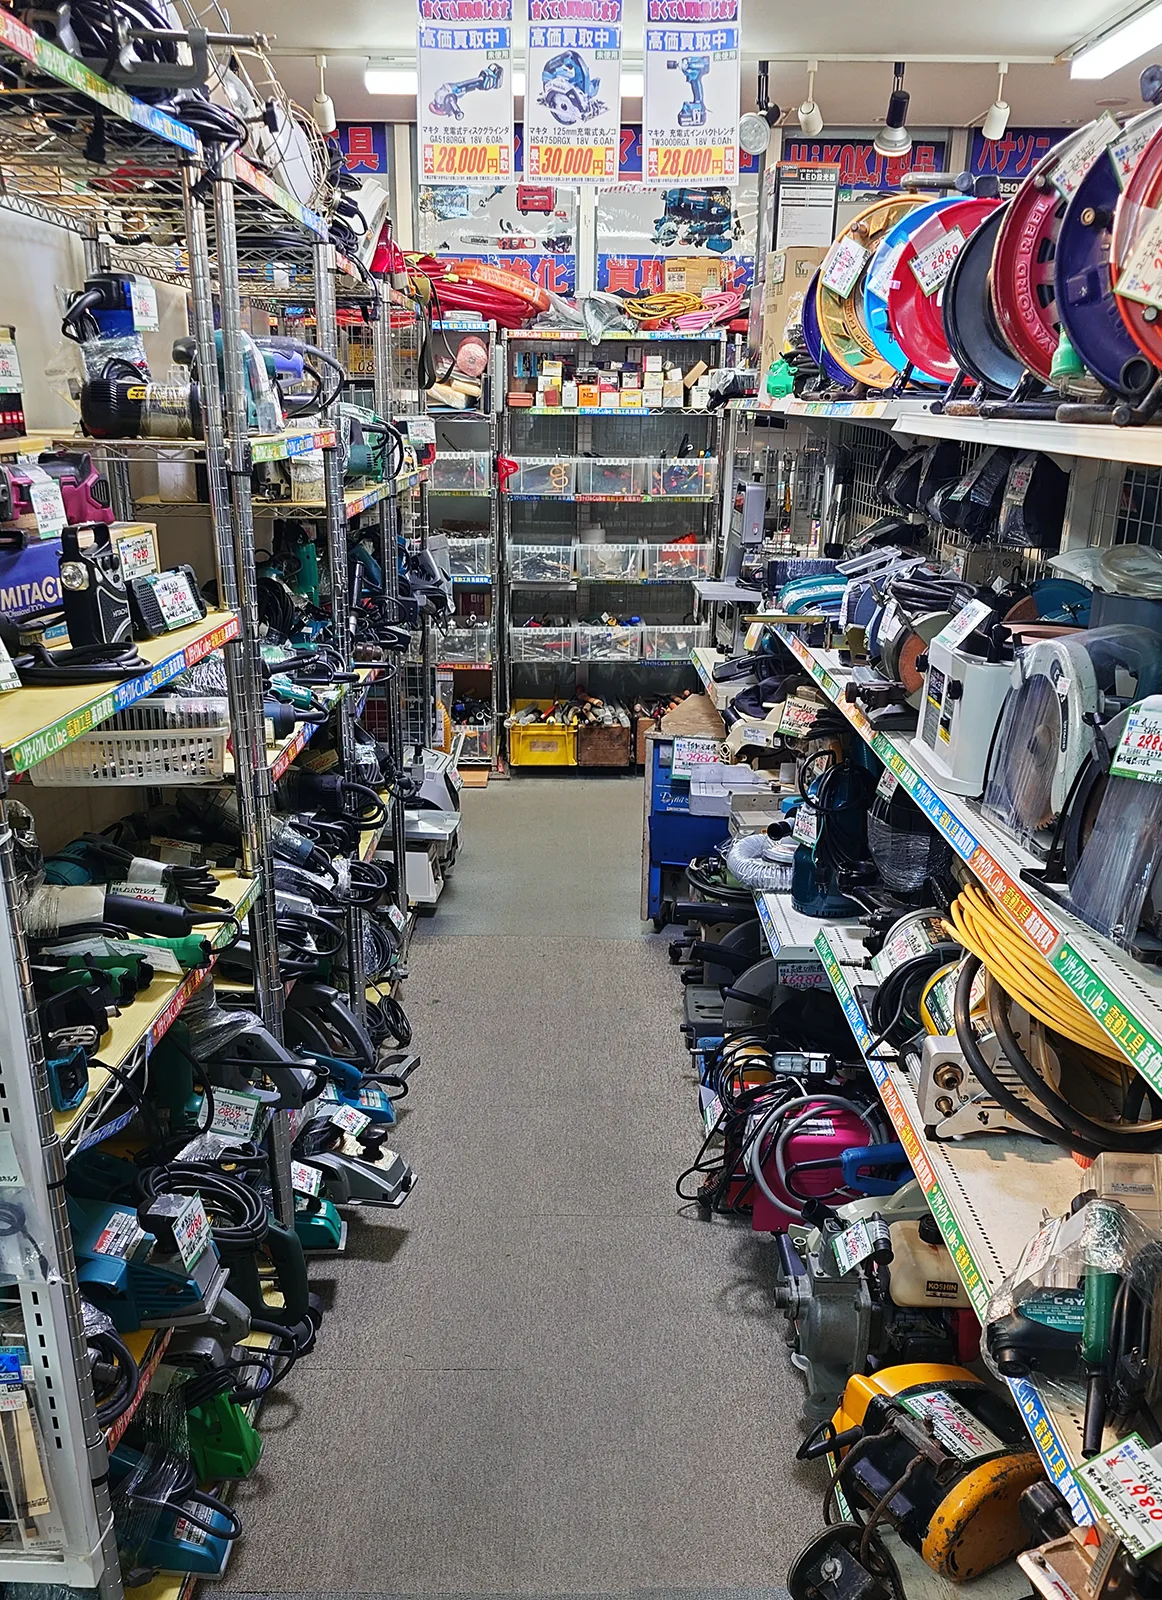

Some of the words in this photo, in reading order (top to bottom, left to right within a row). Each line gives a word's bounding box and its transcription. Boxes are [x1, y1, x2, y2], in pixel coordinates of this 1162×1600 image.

[422, 126, 440, 134] マキタ
[529, 127, 548, 135] マキタ
[648, 129, 665, 137] マキタ
[471, 136, 483, 144] 18V
[486, 136, 504, 144] 6.0Ah
[576, 137, 589, 145] 18V
[593, 137, 615, 145] 6.0Ah
[695, 138, 708, 146] 18V
[711, 137, 732, 145] 6.0Ah
[1019, 202, 1050, 255] REEL
[974, 852, 1007, 897] リサイクルCube
[1002, 887, 1055, 951] 電動工具高価買取
[1060, 954, 1109, 1018] リサイクルCube
[932, 1190, 959, 1251] リサイクルCube
[928, 1282, 957, 1292] KOSHIN
[1128, 1503, 1151, 1526] 2178
